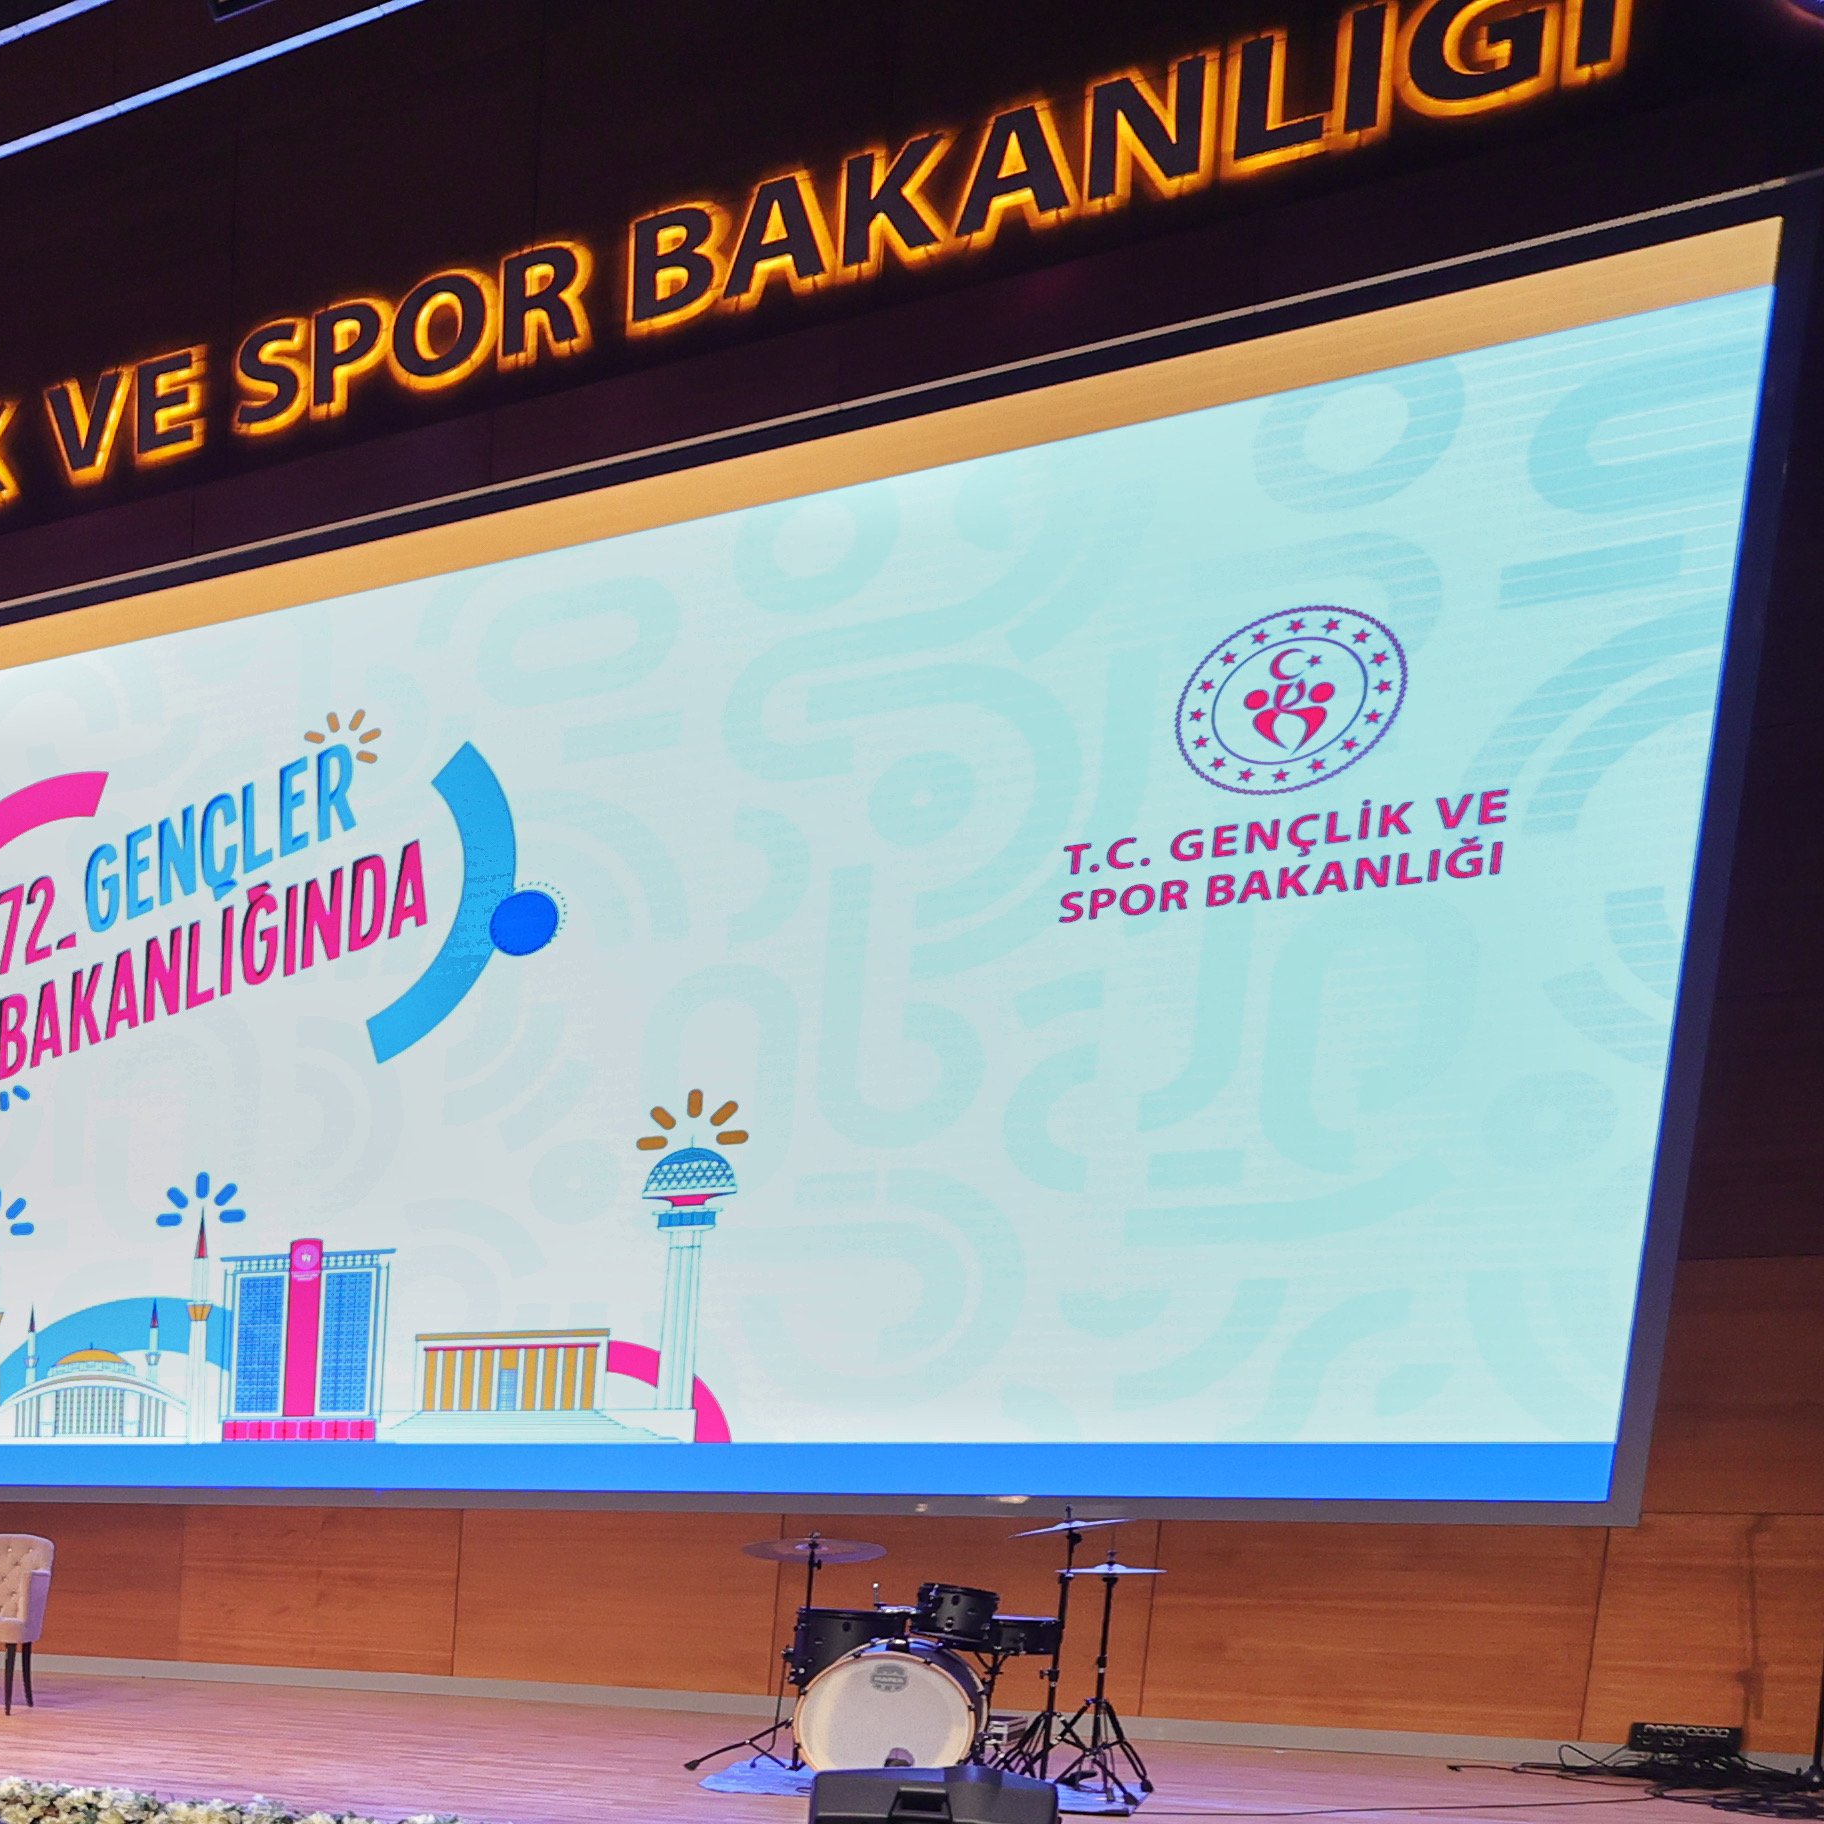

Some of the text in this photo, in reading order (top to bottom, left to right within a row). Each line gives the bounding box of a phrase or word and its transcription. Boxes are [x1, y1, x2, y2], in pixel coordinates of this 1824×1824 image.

[44, 344, 208, 486] VE
[234, 241, 592, 436] SPOR
[85, 744, 357, 933] GENÇLER
[1059, 837, 1504, 923] SPOR BAKANLIĞI
[1063, 789, 1509, 875] T.C. GENÇLİK VE
